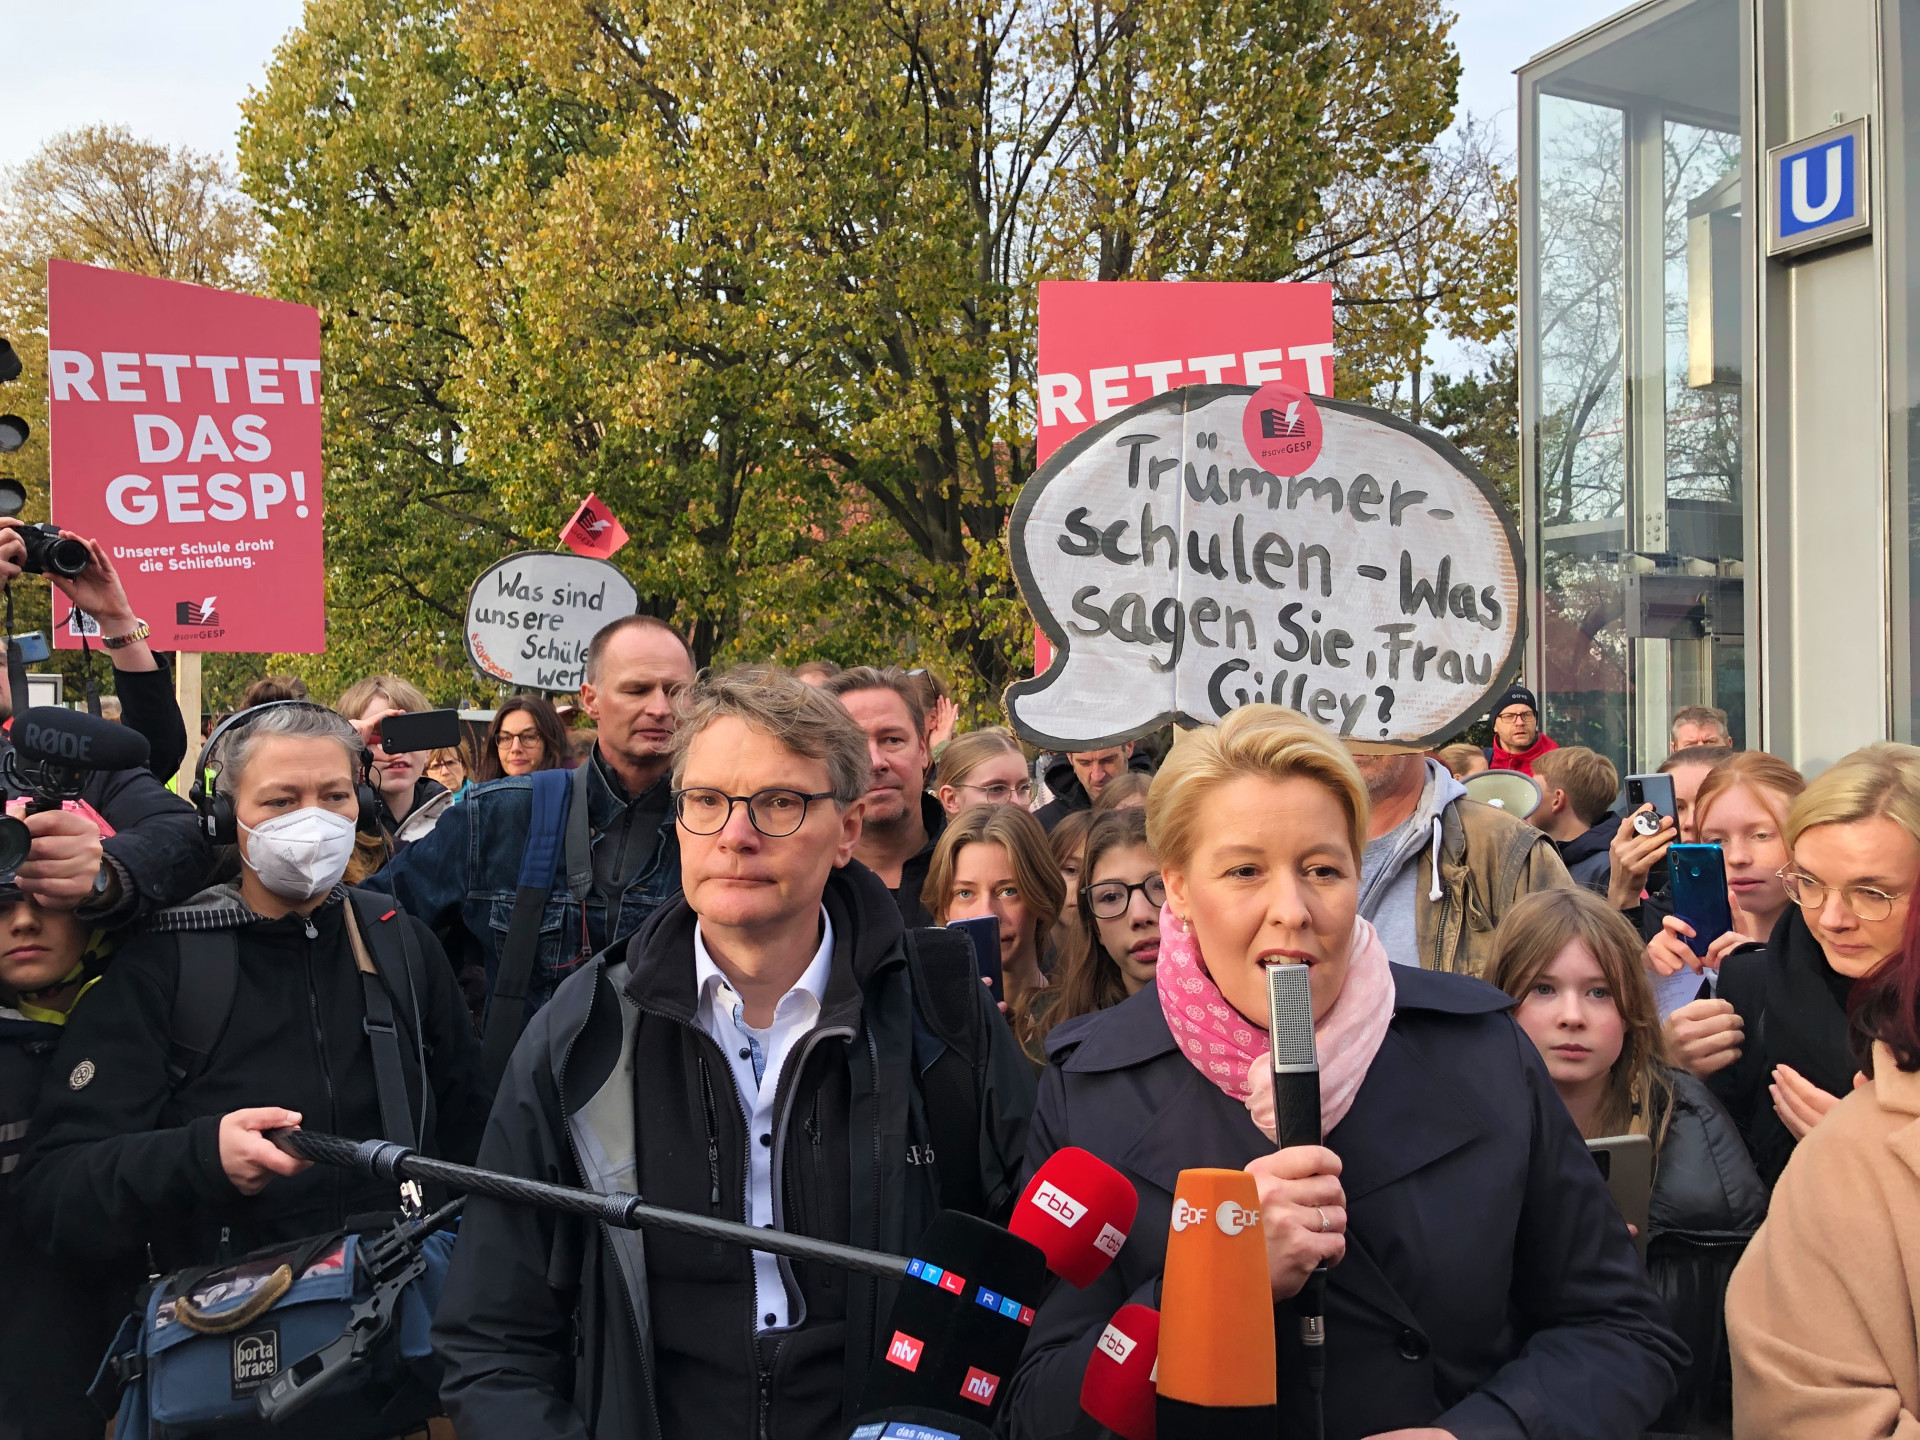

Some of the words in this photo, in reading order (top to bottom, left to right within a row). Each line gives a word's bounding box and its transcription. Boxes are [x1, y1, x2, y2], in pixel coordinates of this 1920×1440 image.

[1791, 144, 1842, 223] U
[50, 350, 321, 405] RETTET
[133, 413, 272, 463] DAS
[1261, 440, 1312, 459] #saveGESP
[1115, 432, 1455, 528] Trümmer-
[105, 470, 309, 525] GESP!
[113, 546, 176, 558] Unserer
[180, 541, 231, 555] Schule
[235, 538, 274, 552] droht
[1056, 503, 1332, 597] schulen
[139, 559, 164, 572] die
[168, 555, 256, 571] Schließung.
[498, 571, 544, 601] Was
[552, 581, 605, 611] sind
[475, 607, 564, 631] unsere
[1066, 585, 1258, 673] sagen
[173, 629, 226, 642] #saveGESP
[520, 634, 588, 664] Schüle
[470, 632, 513, 680] #savegesp
[25, 723, 93, 760] RØDE
[1037, 1191, 1075, 1220] rbb
[1099, 1233, 1121, 1253] rbb
[910, 1261, 958, 1291] RTL
[981, 1291, 1031, 1323] RTL
[237, 1343, 274, 1362] porta
[891, 1340, 918, 1363] ntv
[1101, 1332, 1126, 1357] rbb
[237, 1359, 275, 1379] brace
[967, 1377, 995, 1398] ntv
[895, 1425, 916, 1439] das
